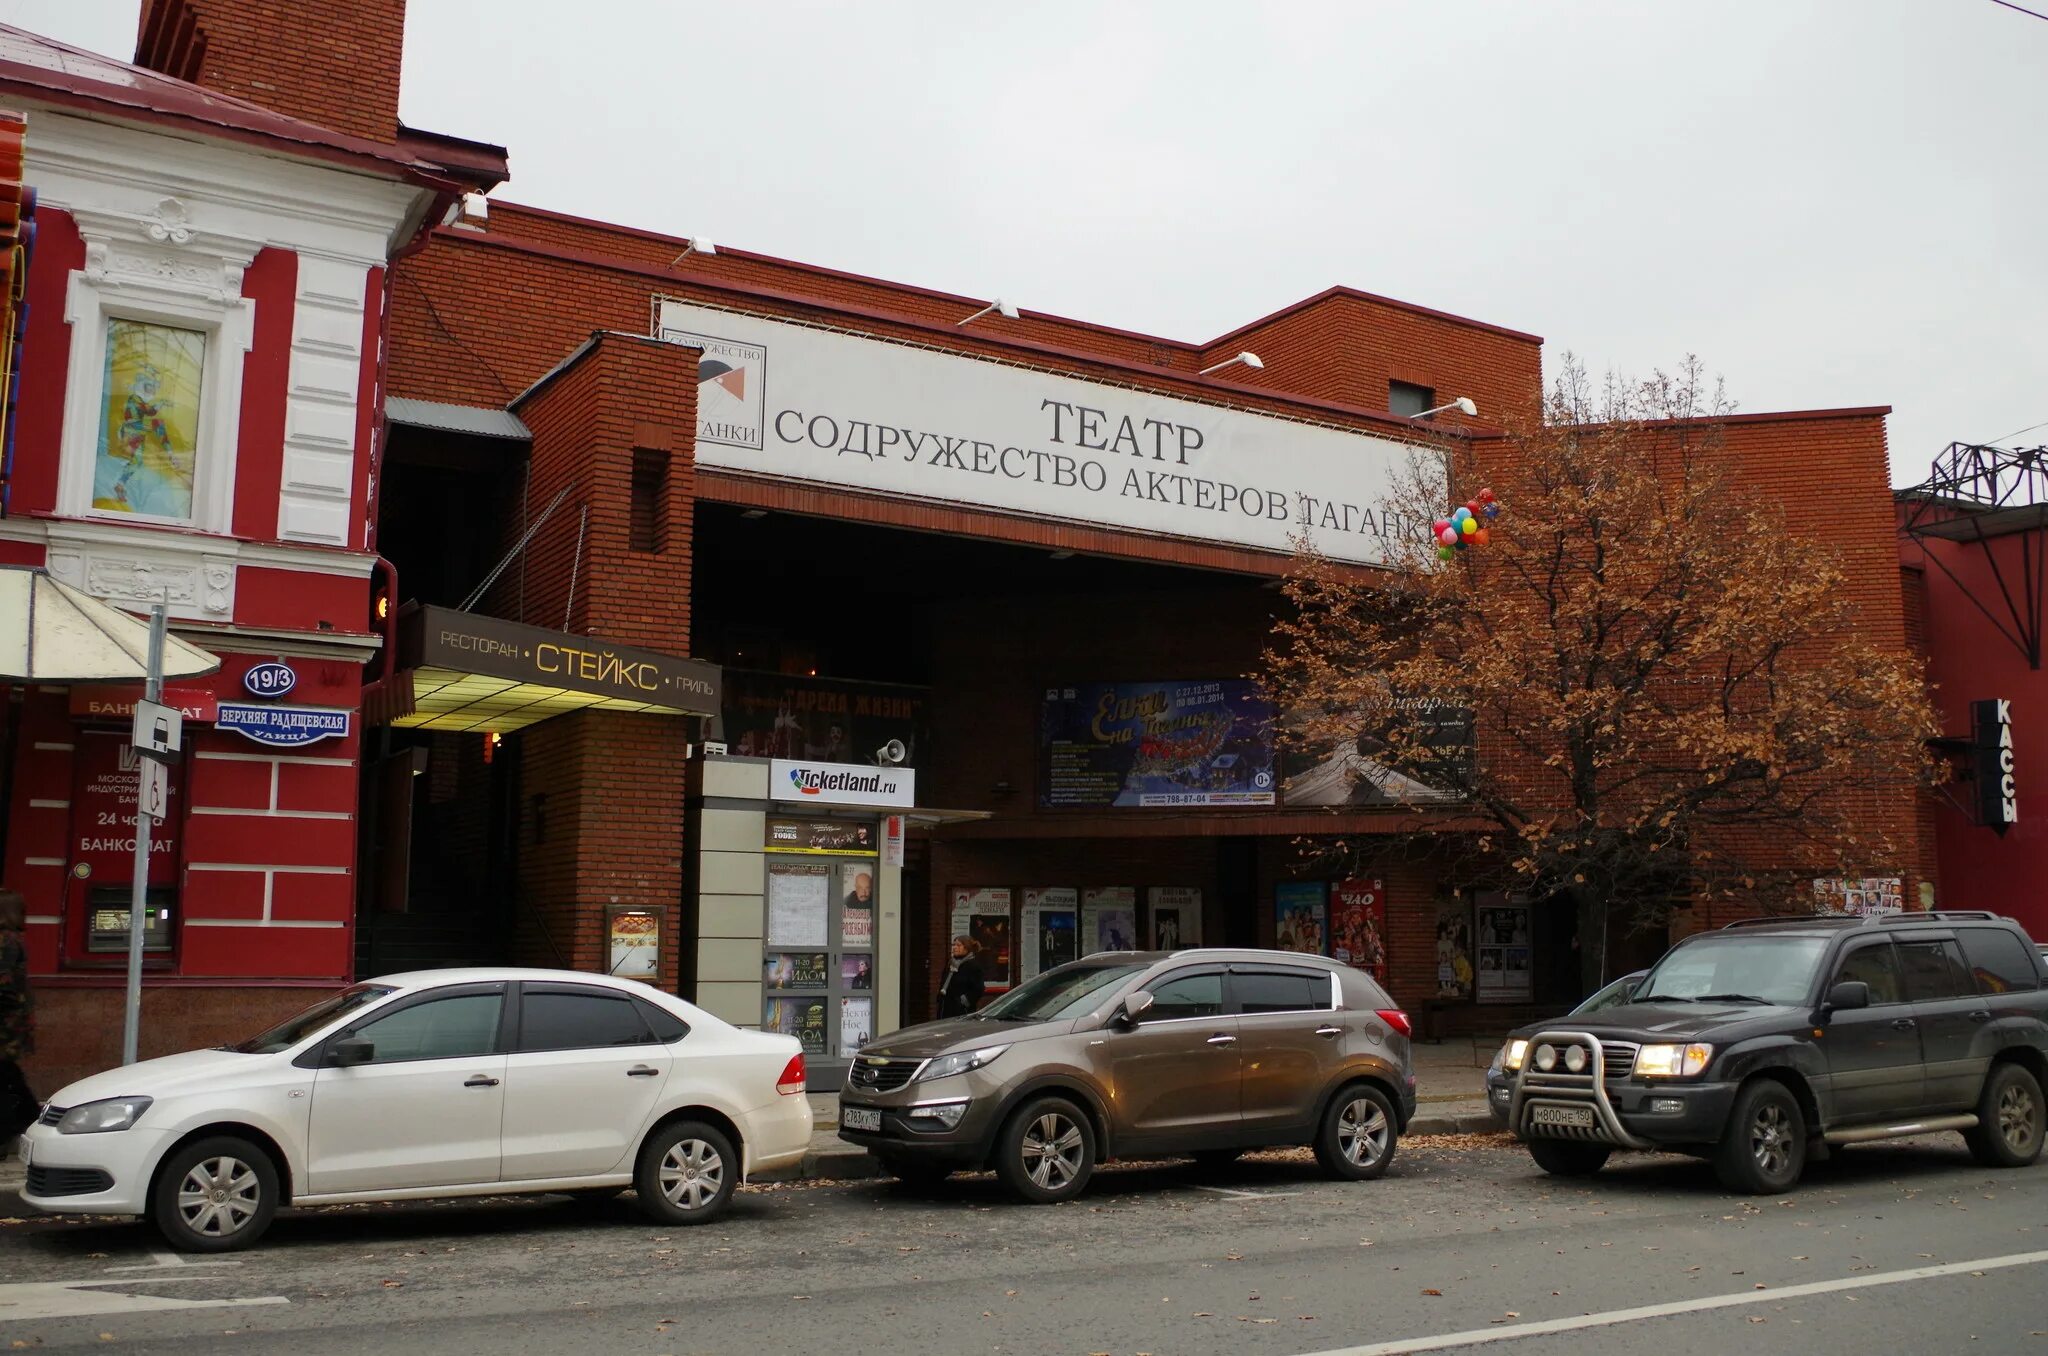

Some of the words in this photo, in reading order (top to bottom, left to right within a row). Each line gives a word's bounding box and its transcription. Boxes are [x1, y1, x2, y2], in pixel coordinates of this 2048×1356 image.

[700, 420, 756, 443] АНКИ
[1041, 398, 1204, 465] ТЕАТР
[775, 409, 1107, 493] СОДРУЖЕСТВО
[1120, 467, 1289, 522] АКТЕРОВ
[1296, 496, 1437, 546] ТАГАНК
[440, 631, 518, 660] РЕСТОРАН
[536, 643, 659, 691] СТЕЙКС
[676, 676, 714, 696] ГРИЛЬ
[250, 669, 291, 691] 19/3
[89, 701, 202, 718] БАНАТ
[221, 709, 268, 724] ВЕРХНЯЯ
[270, 712, 344, 733] РАДИЩЕВСКАЯ
[254, 729, 310, 741] УЛИЦА
[1997, 698, 2018, 823] КАССЫ
[87, 784, 176, 796] ИНДУСТРИЙ
[798, 768, 896, 794] Ticketland.ru
[98, 812, 116, 825] 24
[122, 815, 163, 827] чаа
[81, 838, 173, 853] БАНКОАТ
